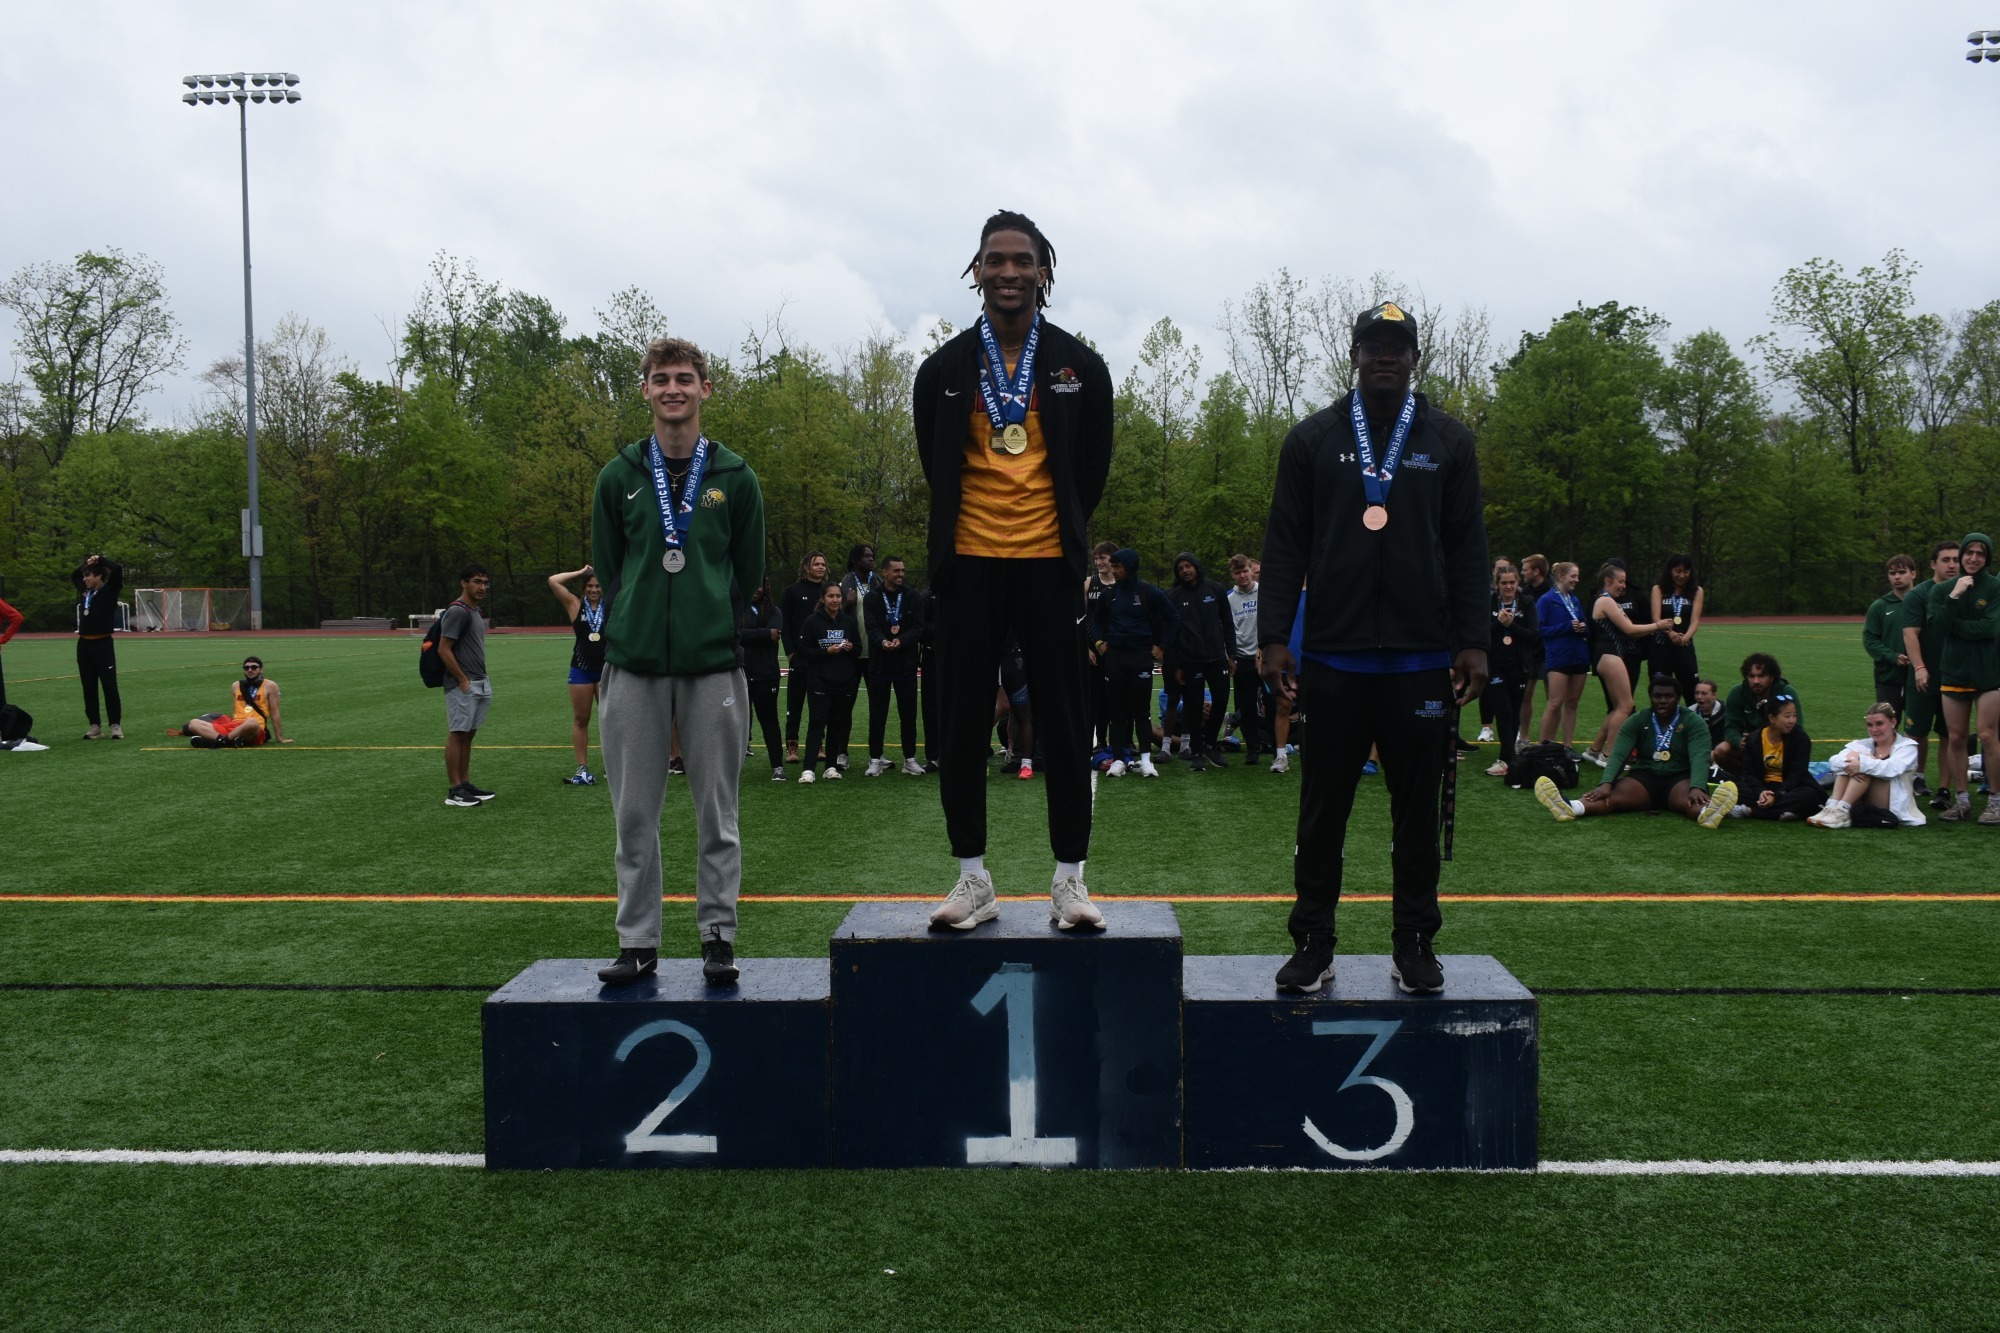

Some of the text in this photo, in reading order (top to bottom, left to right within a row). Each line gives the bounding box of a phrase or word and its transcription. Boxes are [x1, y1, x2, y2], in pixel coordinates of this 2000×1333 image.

[981, 323, 1008, 391] EAST CONFERENCE
[1018, 351, 1034, 393] ATLANTIC
[1027, 328, 1040, 351] EAST
[980, 381, 1001, 423] ATLANTIC
[1353, 402, 1364, 421] EAST
[1400, 404, 1414, 424] EAST
[696, 438, 706, 458] EAST
[1356, 421, 1372, 463] ATLANTIC
[1384, 423, 1406, 470] CONFERENCE
[654, 468, 667, 489] EAST
[683, 457, 702, 502] CONFERENCE
[658, 490, 675, 531] ATLANTIC
[827, 629, 845, 639] MU
[967, 962, 1078, 1164] 1
[615, 1019, 720, 1153] 2
[1302, 1019, 1415, 1161] 3
